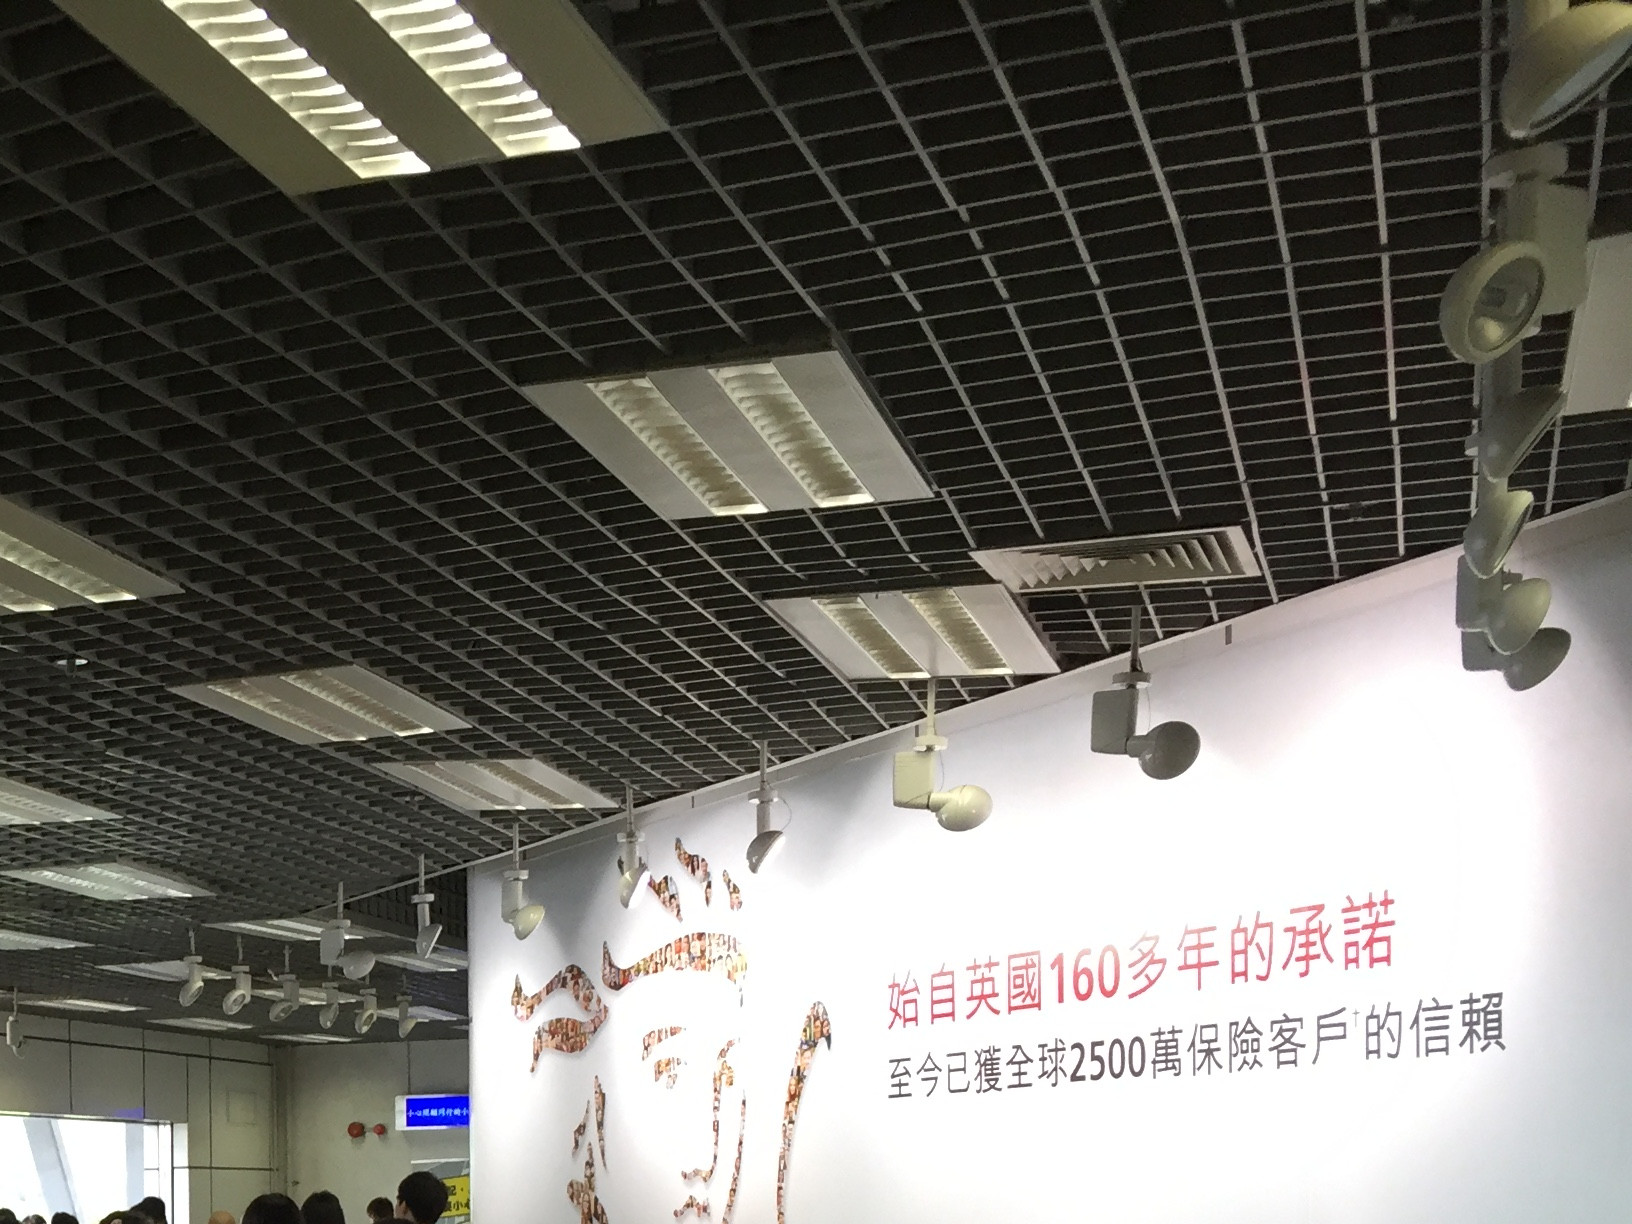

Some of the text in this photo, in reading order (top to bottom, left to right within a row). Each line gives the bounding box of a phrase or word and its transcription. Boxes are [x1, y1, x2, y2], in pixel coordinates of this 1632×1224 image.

[888, 889, 1396, 1031] 始自英國160多年的承諾
